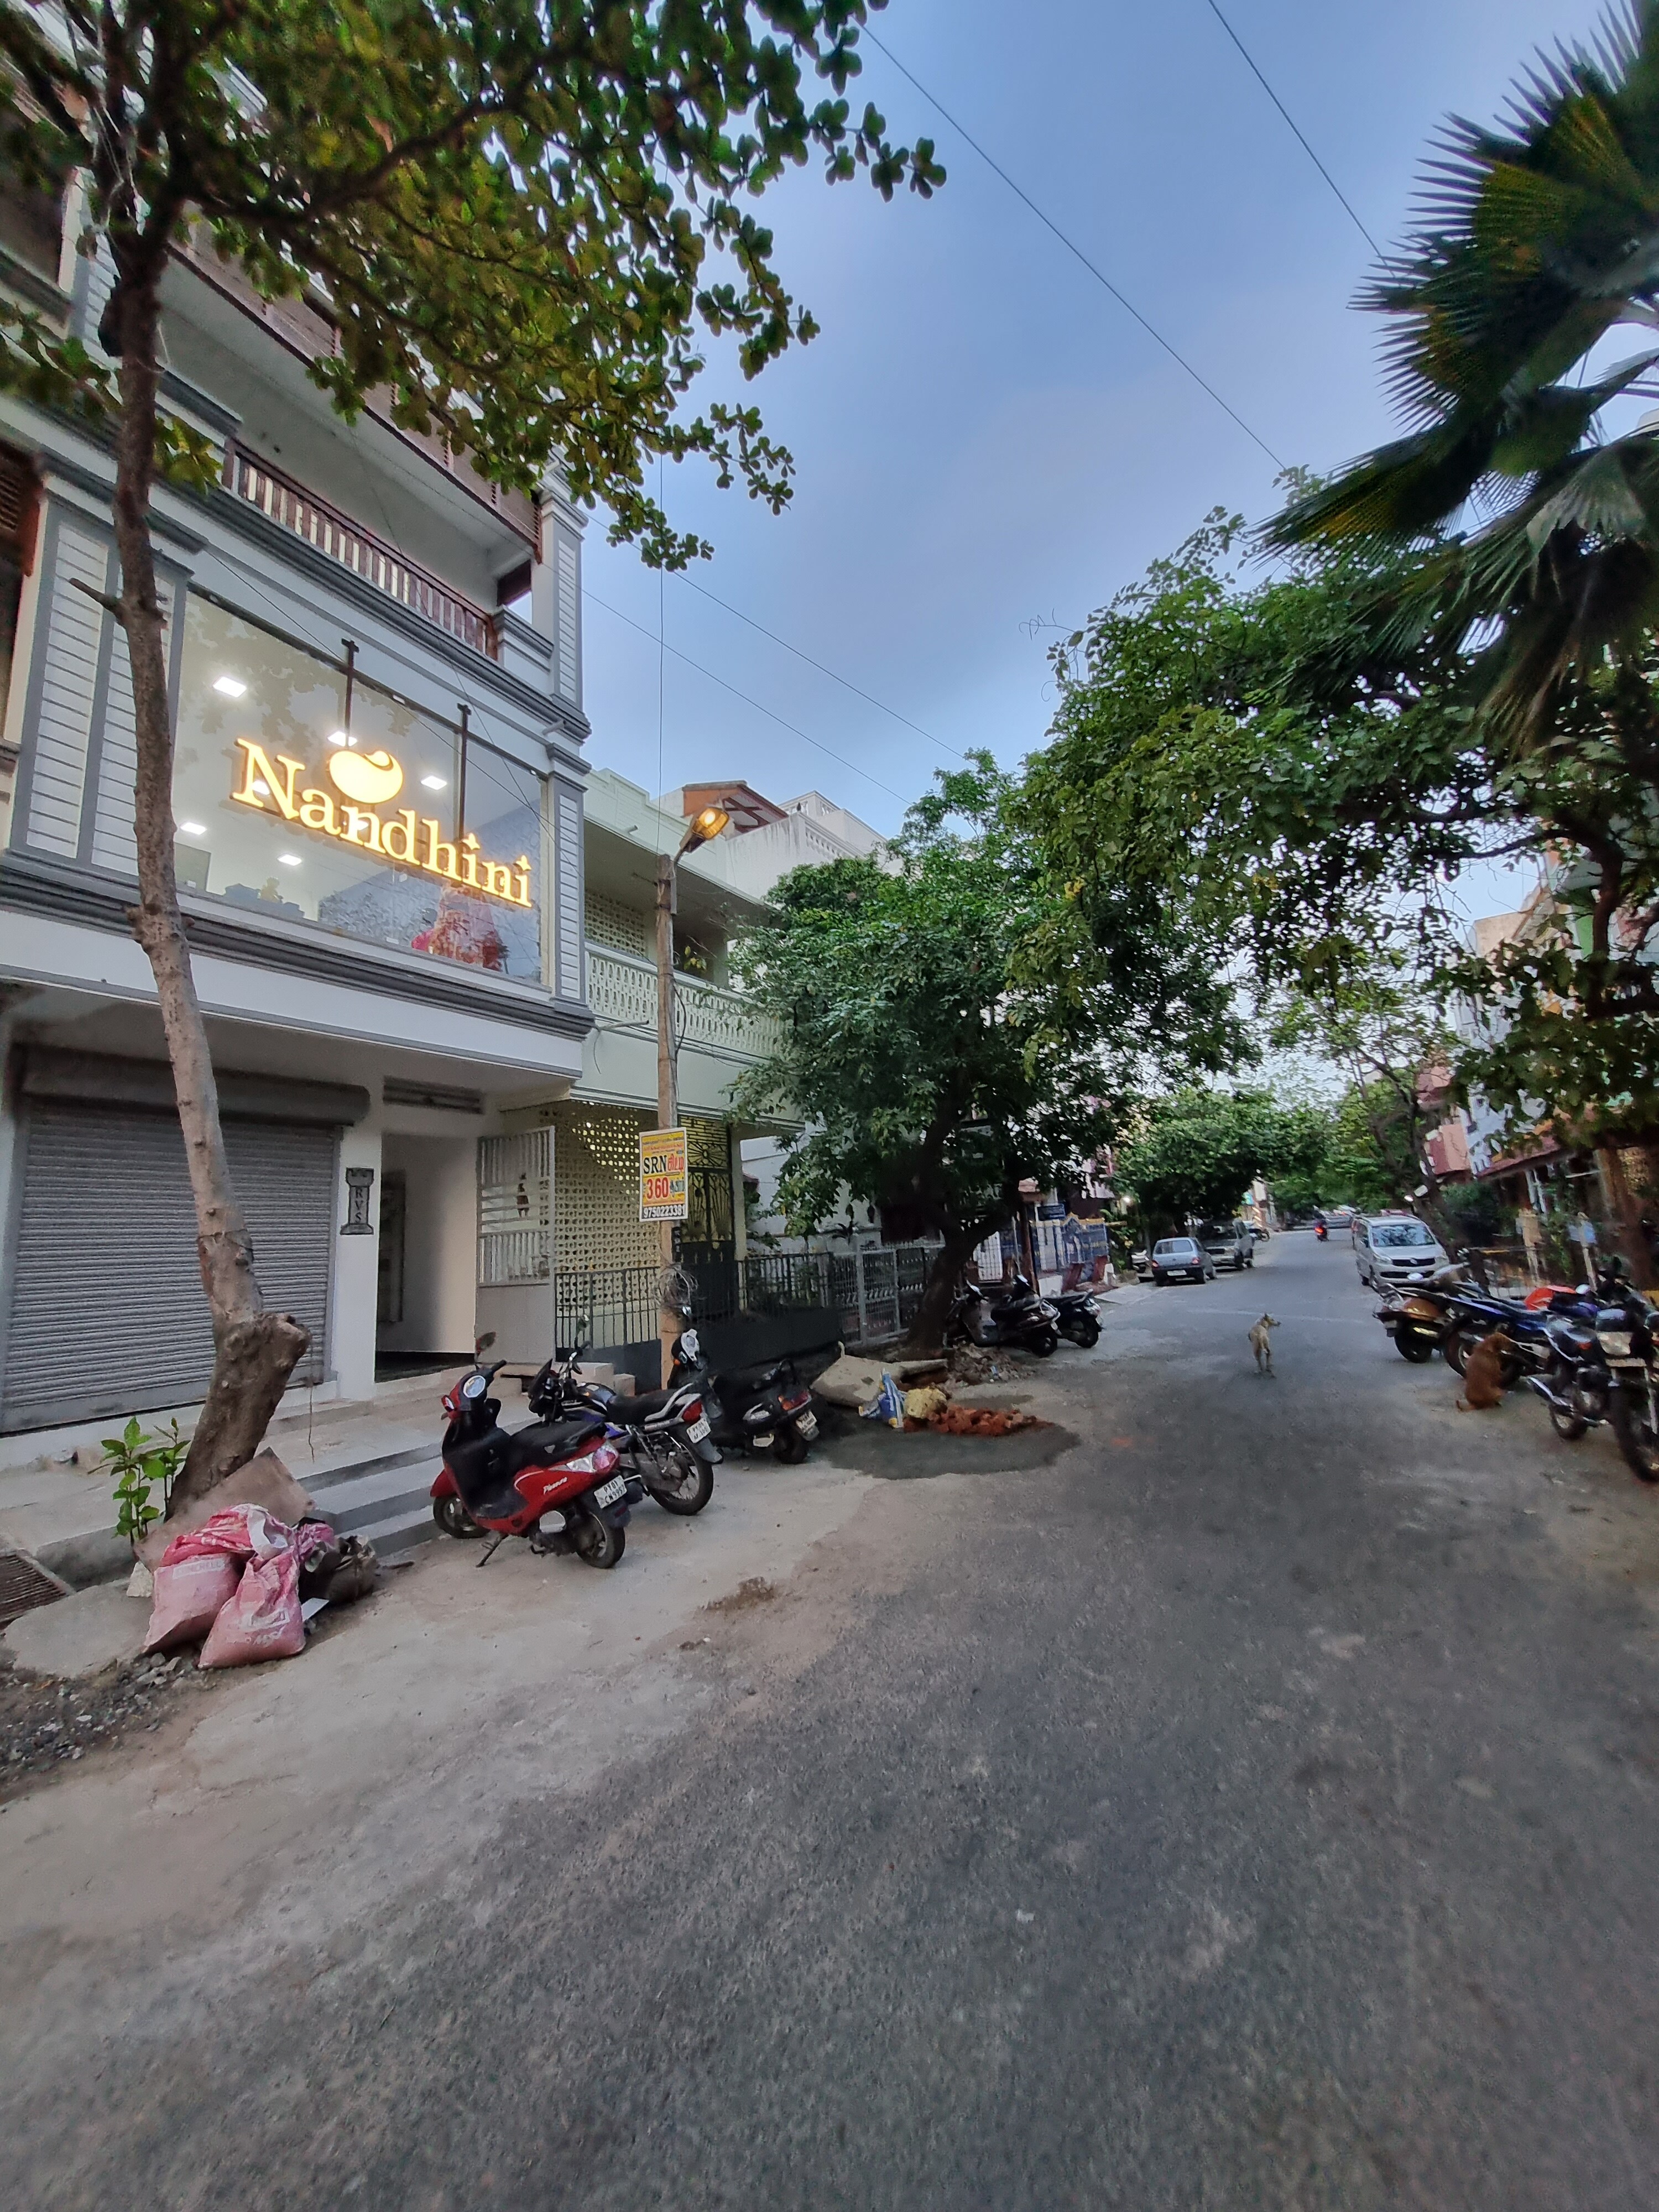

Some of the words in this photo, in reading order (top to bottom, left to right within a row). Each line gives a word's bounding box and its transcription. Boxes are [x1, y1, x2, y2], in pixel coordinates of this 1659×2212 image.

[232, 738, 532, 907] Nandhini
[643, 1155, 667, 1174] SRN
[646, 1177, 669, 1199] 360
[355, 1187, 364, 1224] RVS
[643, 1204, 686, 1218] 9750223381
